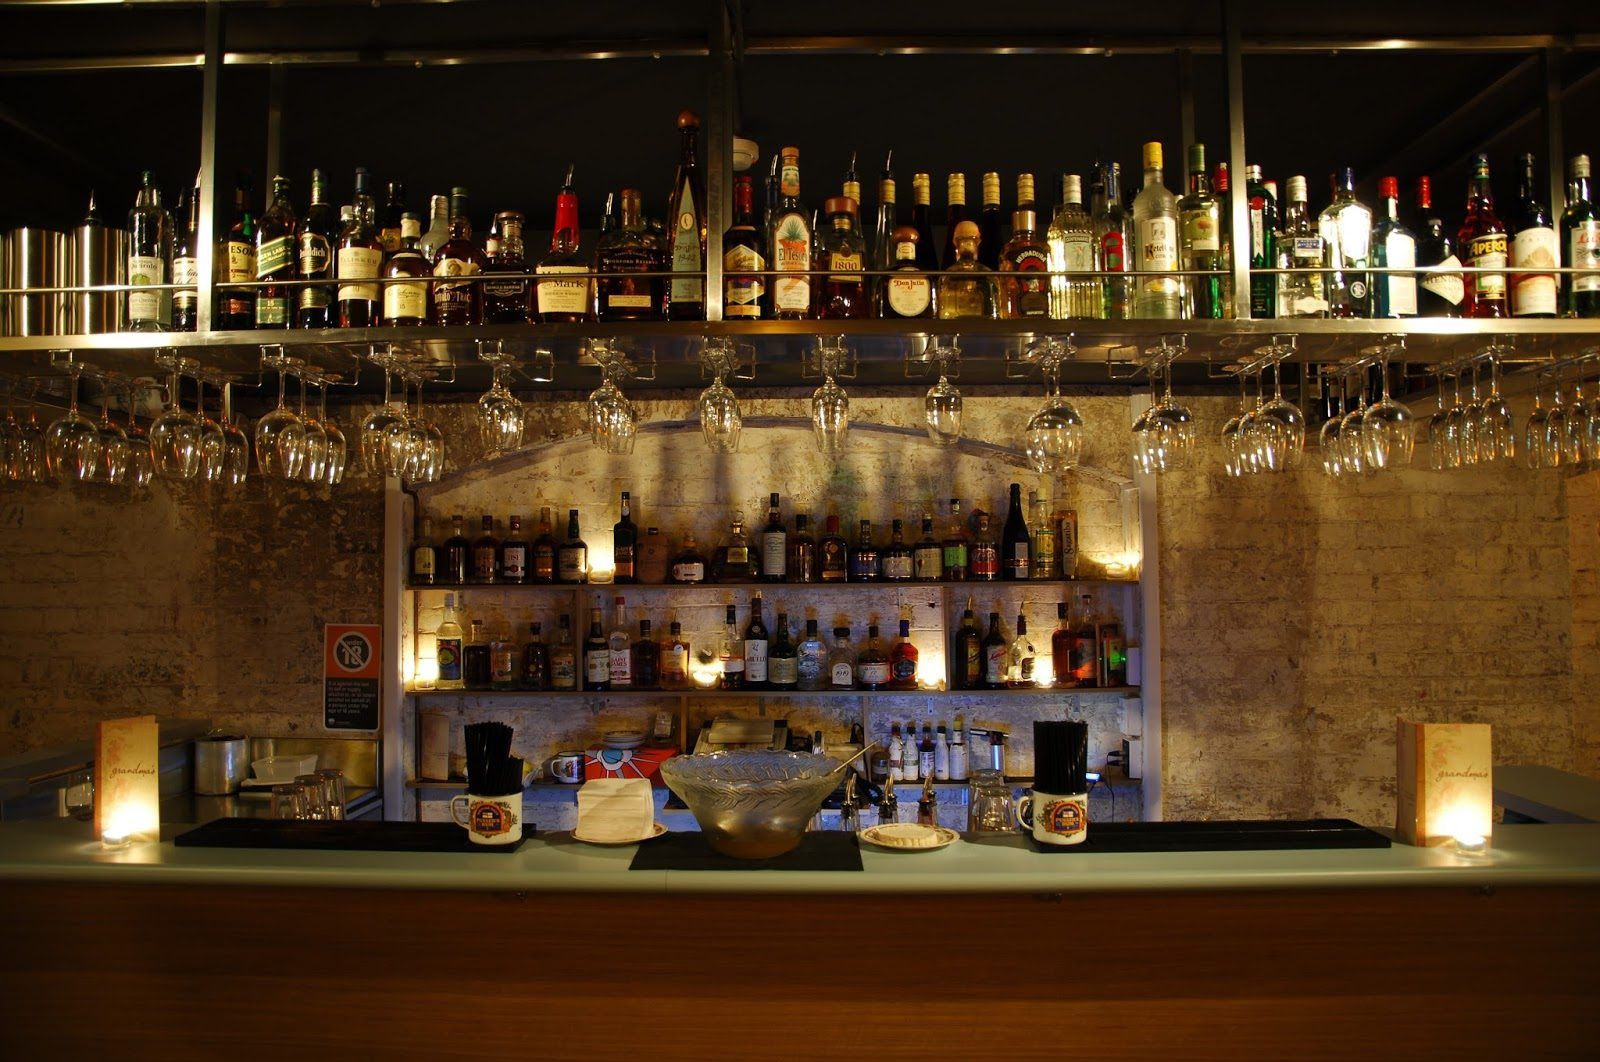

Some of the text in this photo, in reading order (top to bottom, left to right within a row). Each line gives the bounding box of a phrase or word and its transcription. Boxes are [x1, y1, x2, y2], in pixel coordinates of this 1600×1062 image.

[834, 262, 857, 270] 1800
[552, 280, 586, 289] Mark
[342, 645, 363, 666] 18
[109, 762, 156, 779] grandma's
[1435, 765, 1489, 782] grandma's
